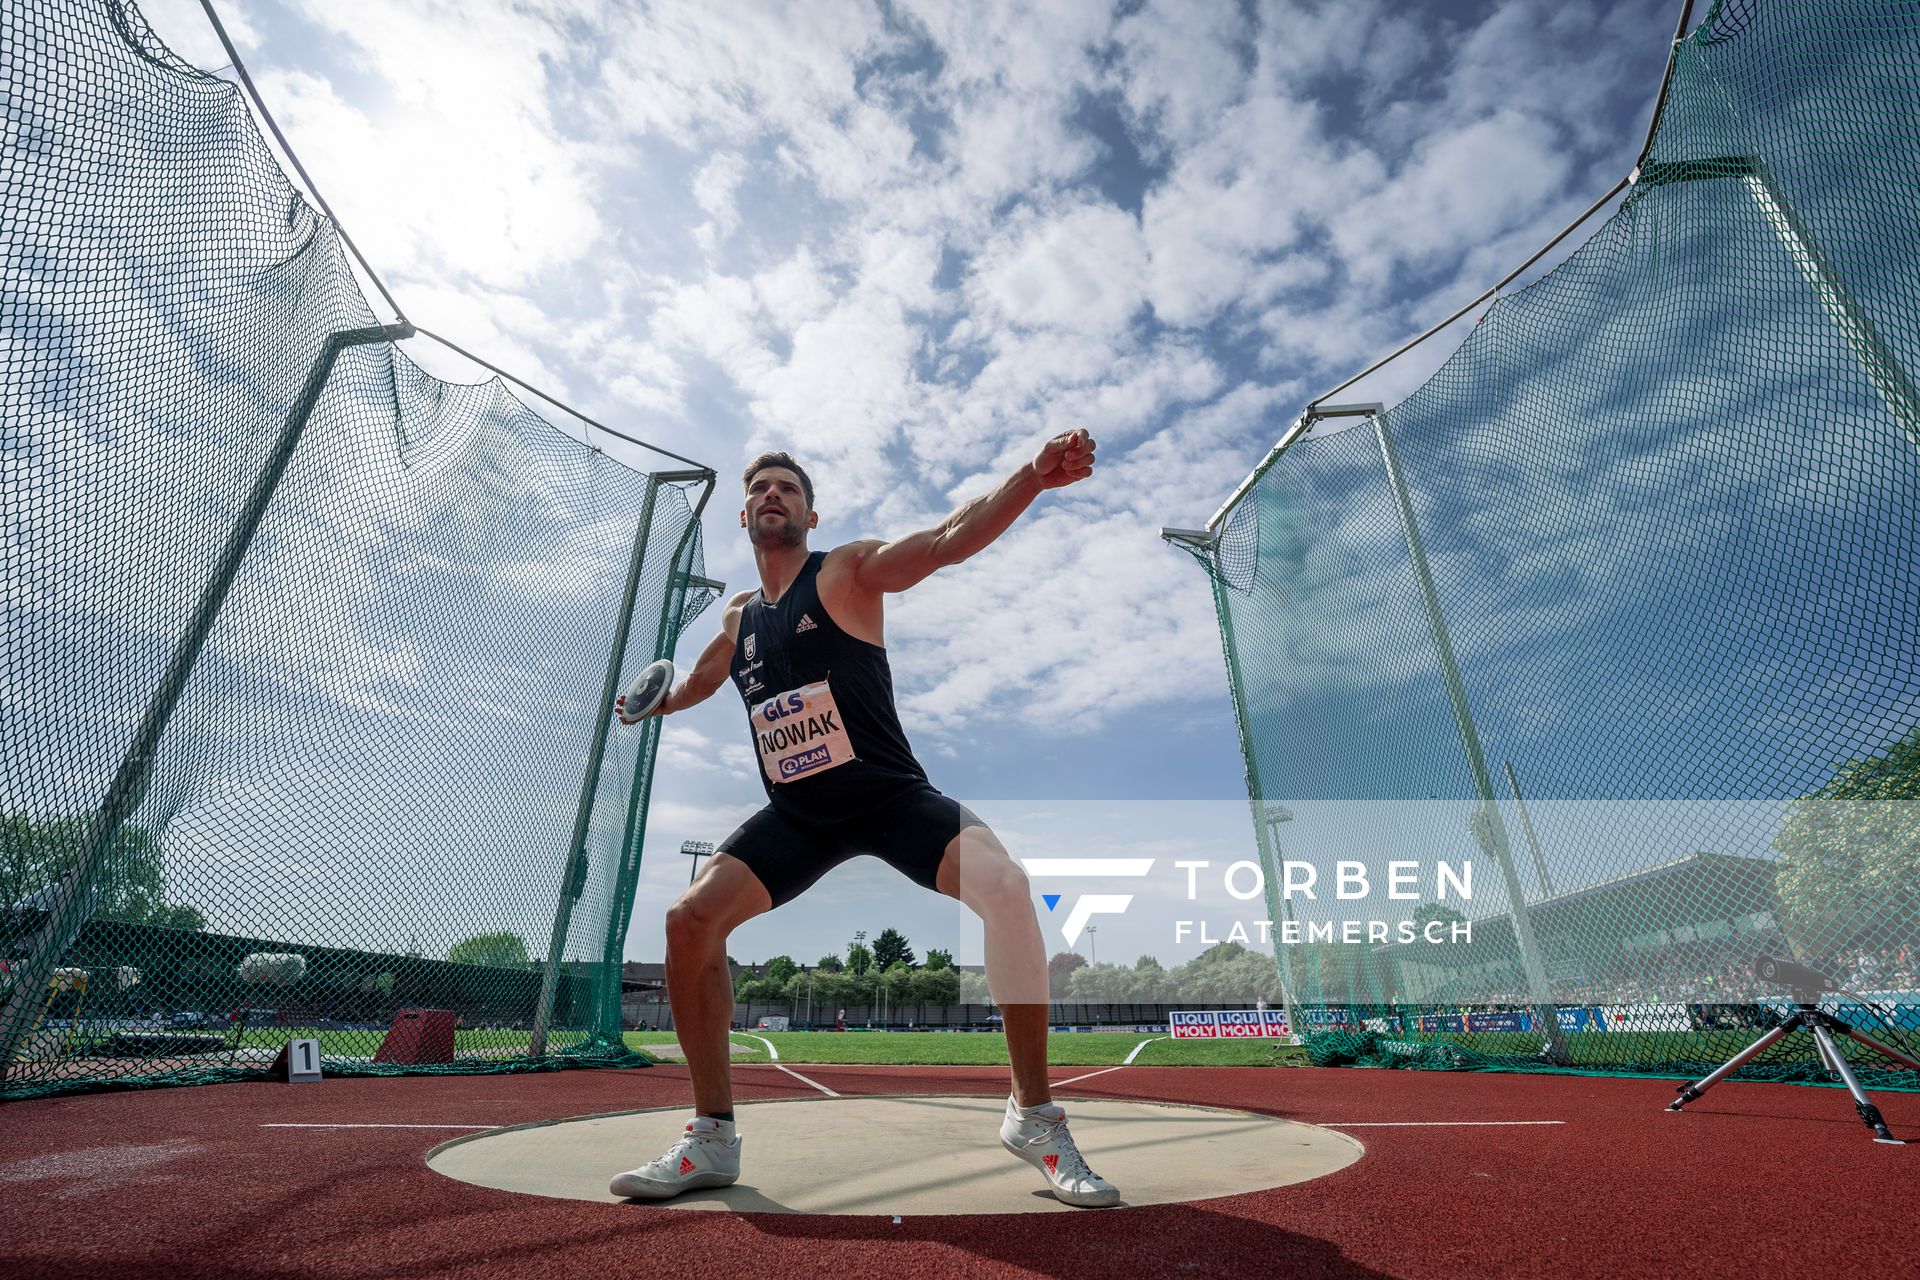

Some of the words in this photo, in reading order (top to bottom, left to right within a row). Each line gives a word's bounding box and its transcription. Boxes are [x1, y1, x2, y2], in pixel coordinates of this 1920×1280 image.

[796, 622, 818, 634] adidas
[762, 710, 840, 754] NOWAK
[798, 748, 828, 766] PLAN
[1174, 1014, 1213, 1025] LIQUI
[1219, 1014, 1258, 1024] LIQUI
[1265, 1013, 1286, 1024] LIQ
[1176, 1026, 1215, 1036] MOLY
[1221, 1025, 1260, 1036] MOLY
[298, 1042, 312, 1070] 1
